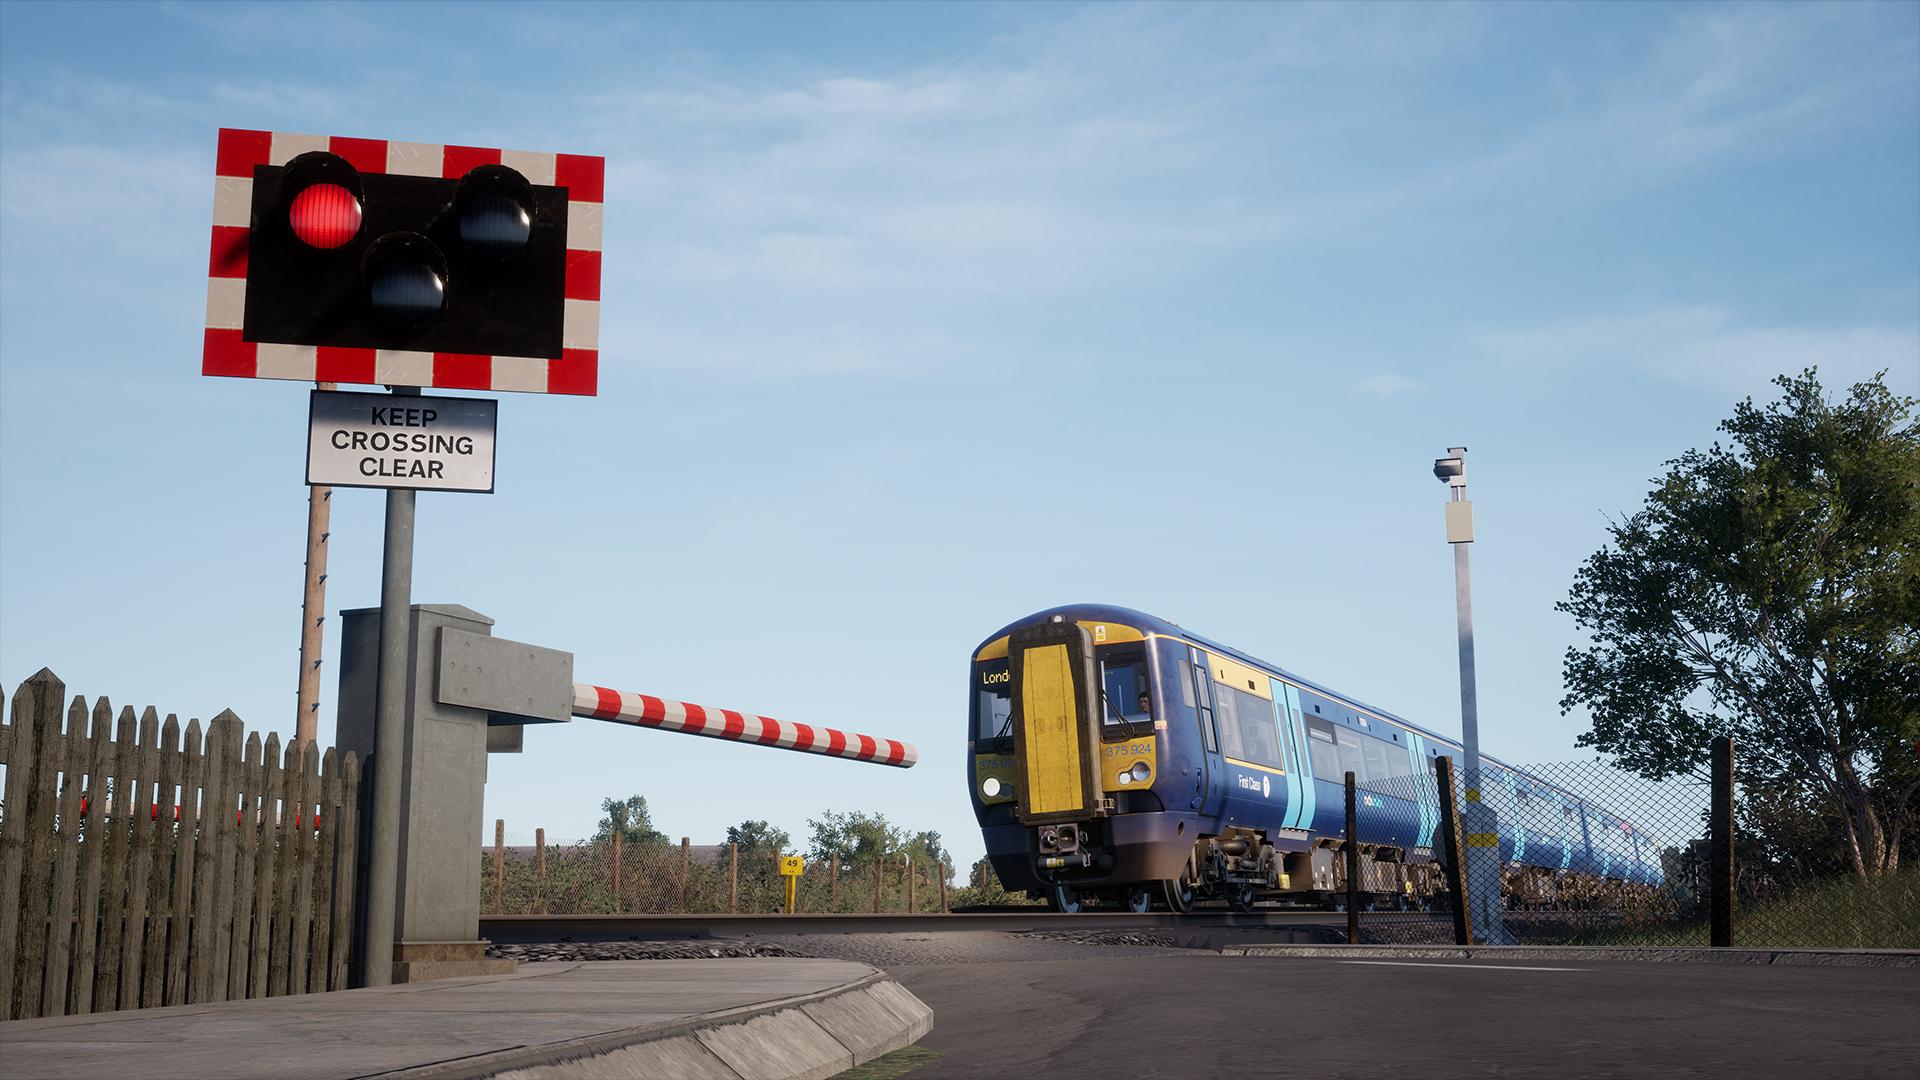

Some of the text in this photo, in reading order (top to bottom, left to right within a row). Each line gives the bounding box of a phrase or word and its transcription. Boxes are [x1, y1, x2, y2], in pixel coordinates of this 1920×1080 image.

[371, 406, 438, 428] KEEP
[331, 430, 473, 455] CROSSING
[359, 456, 444, 479] CLEAR
[1106, 743, 1151, 757] 375 924
[1238, 774, 1249, 789] First
[1249, 776, 1261, 791] Class
[787, 859, 798, 867] 49
